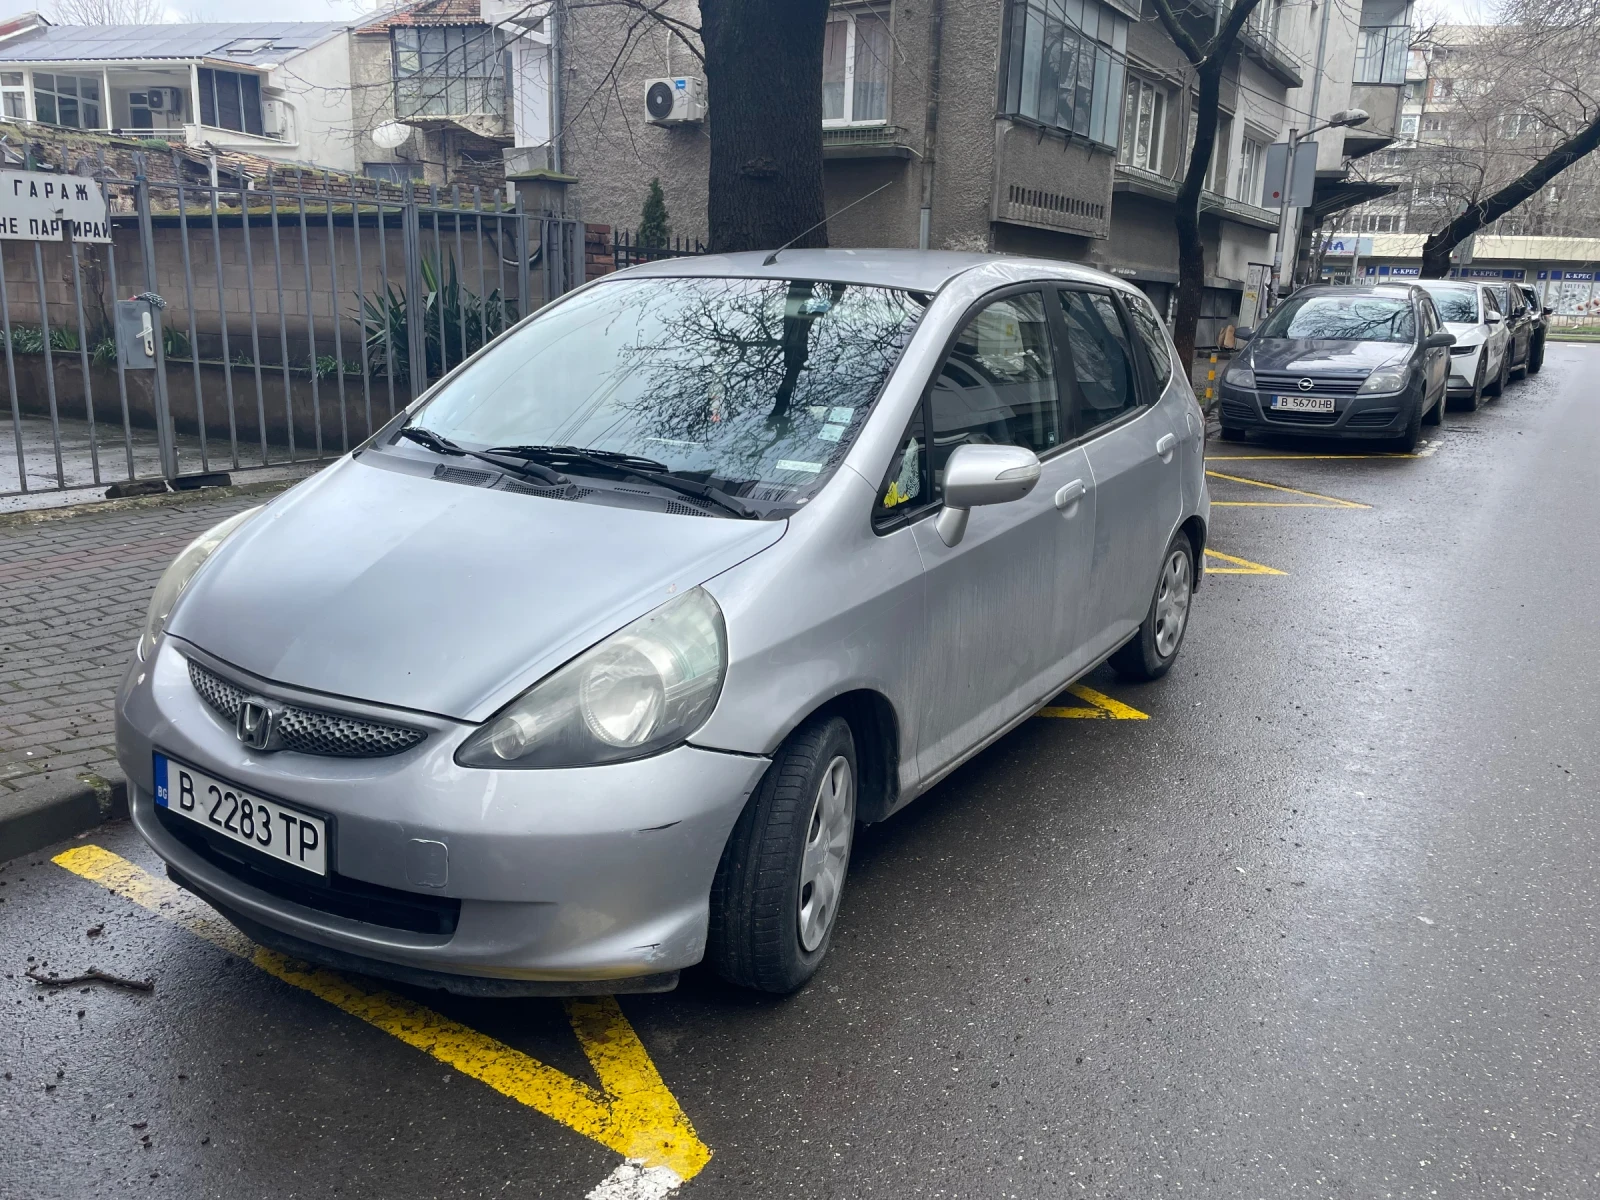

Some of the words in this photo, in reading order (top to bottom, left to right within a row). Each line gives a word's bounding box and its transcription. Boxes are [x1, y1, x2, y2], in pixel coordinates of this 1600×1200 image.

[13, 179, 88, 201] ГАРАЖ
[0, 217, 18, 234] НЕ
[1281, 398, 1288, 407] B
[1293, 398, 1317, 408] 5670
[1318, 400, 1332, 408] HB
[157, 785, 168, 800] BG
[179, 770, 195, 812] B
[208, 784, 272, 846] 2283
[279, 812, 319, 862] TP
